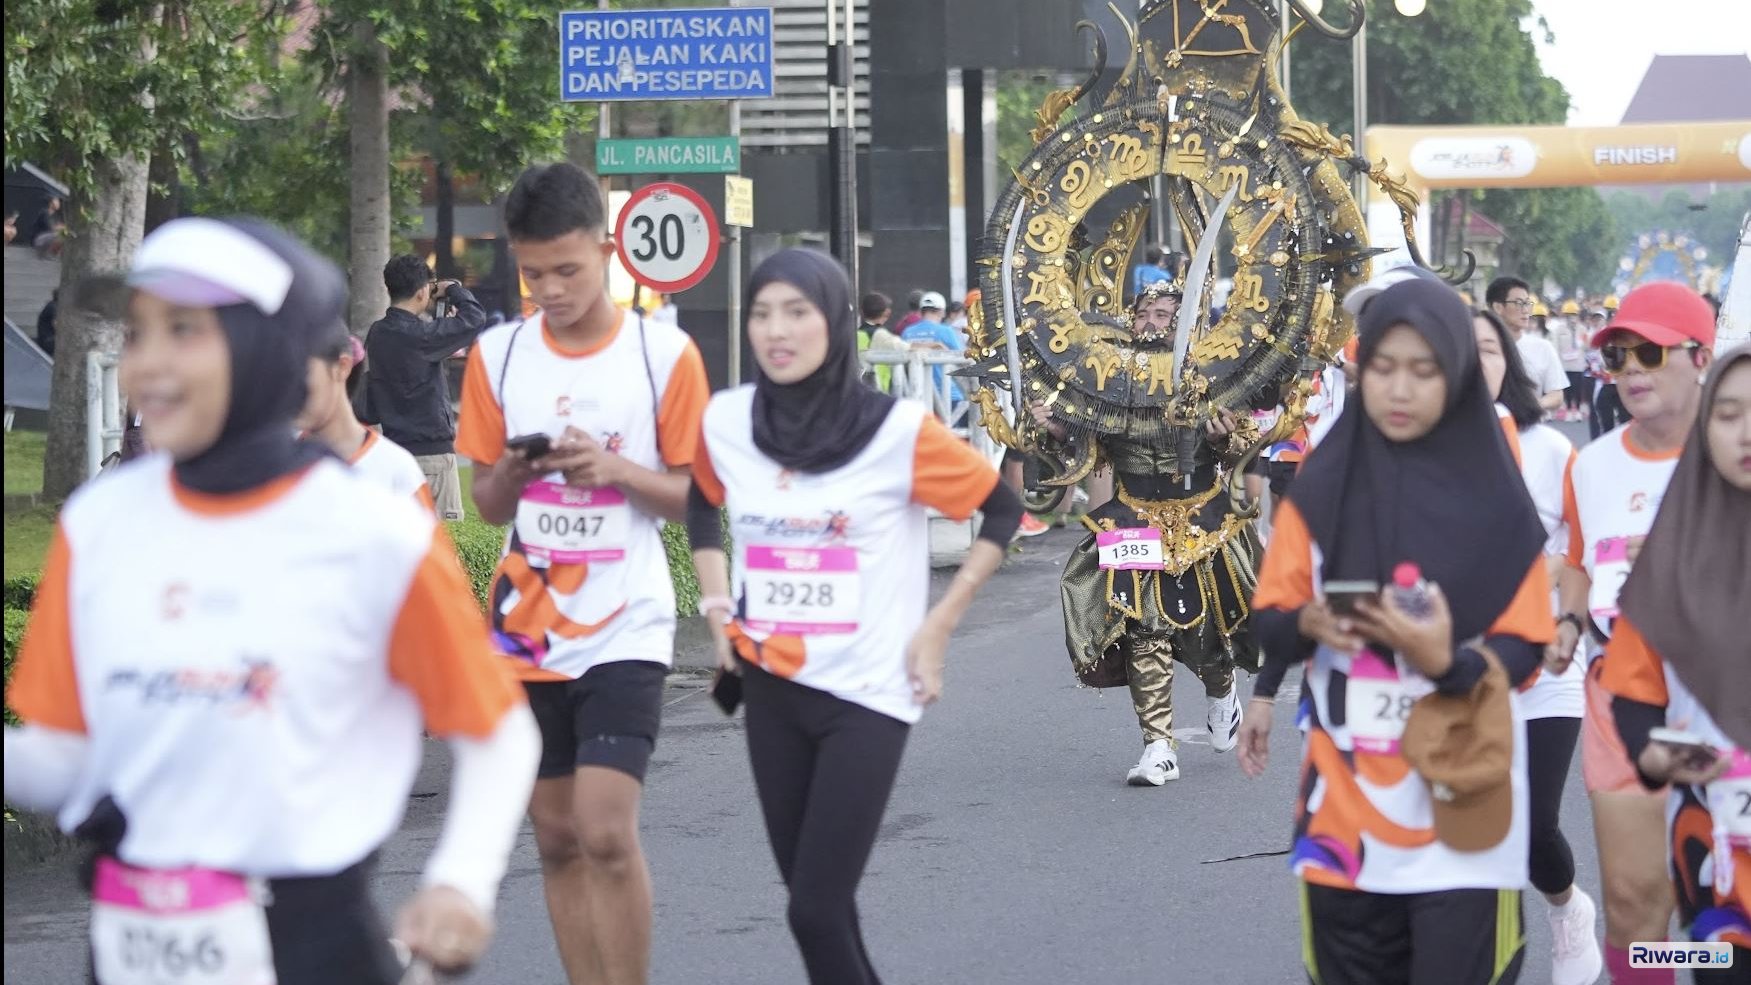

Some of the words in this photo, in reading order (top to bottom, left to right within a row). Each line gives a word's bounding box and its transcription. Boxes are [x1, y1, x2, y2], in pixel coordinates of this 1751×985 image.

[567, 16, 765, 40] PRIORITASKAN
[568, 43, 690, 66] PEJALAN
[701, 43, 765, 64] KAKI
[568, 72, 622, 93] DAN
[632, 69, 765, 92] PESEPEDA
[601, 146, 625, 166] JL.
[635, 145, 734, 165] PANCASILA
[1594, 147, 1677, 165] FINISH
[631, 213, 685, 262] 30
[538, 513, 604, 537] 0047
[1112, 544, 1149, 559] 1385
[765, 581, 834, 607] 2928
